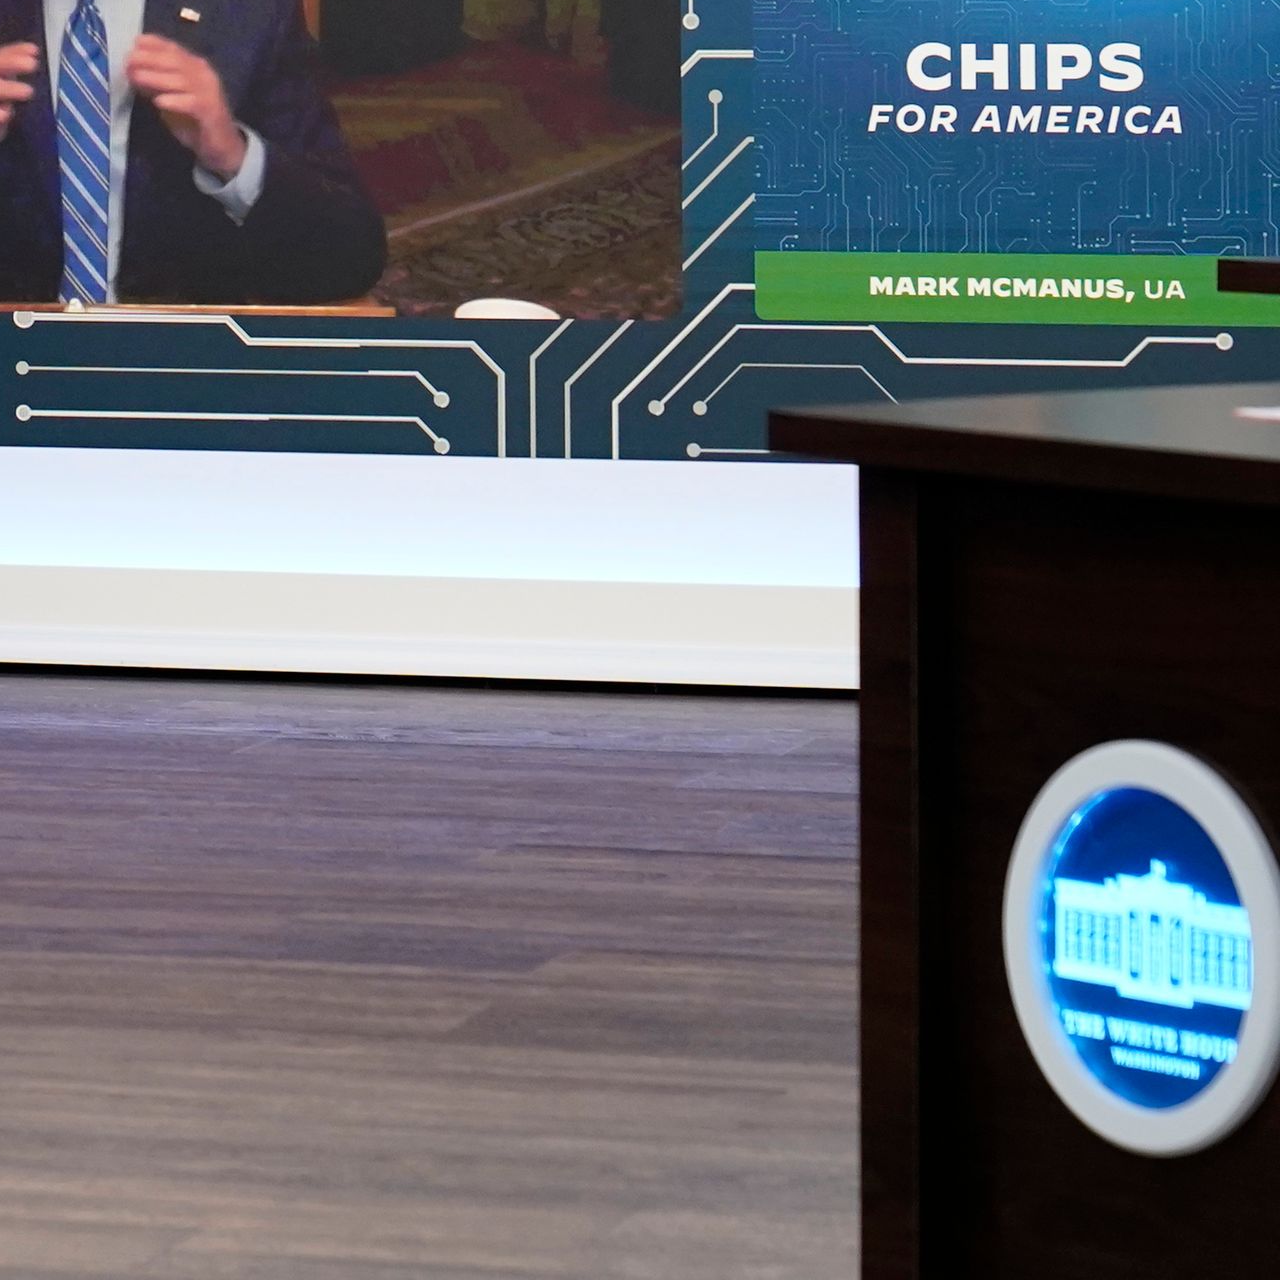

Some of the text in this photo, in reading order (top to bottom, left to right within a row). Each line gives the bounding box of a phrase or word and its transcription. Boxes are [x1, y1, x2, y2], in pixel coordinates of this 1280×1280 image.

[905, 41, 1145, 92] CHIPS
[867, 104, 1183, 135] FOR AMERICA
[869, 276, 1187, 303] MARK MCMANUS, UA
[1061, 1007, 1105, 1040] THE
[1106, 1016, 1178, 1054] WHITE
